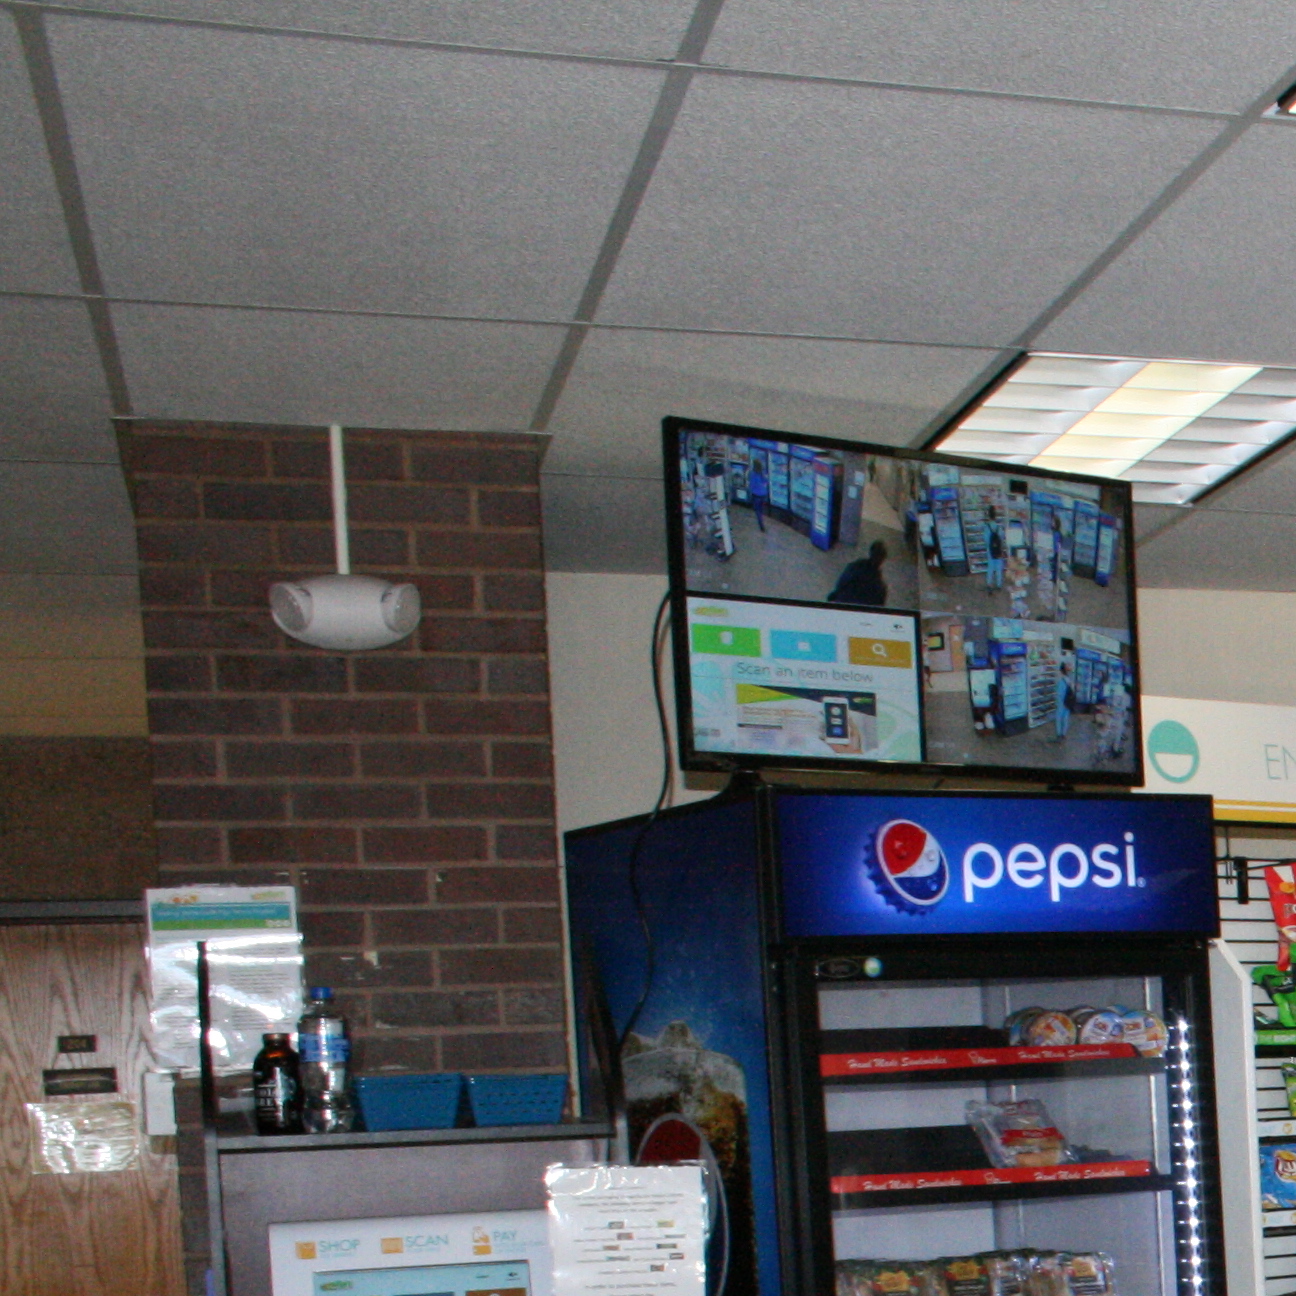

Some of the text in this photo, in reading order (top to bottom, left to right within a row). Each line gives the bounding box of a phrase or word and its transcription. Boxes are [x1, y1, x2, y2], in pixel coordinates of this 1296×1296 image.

[831, 666, 874, 684] below
[963, 832, 1136, 903] pepsi
[405, 1234, 449, 1248] SCAN
[493, 1230, 518, 1241] PAY
[319, 1239, 361, 1253] SHOP
